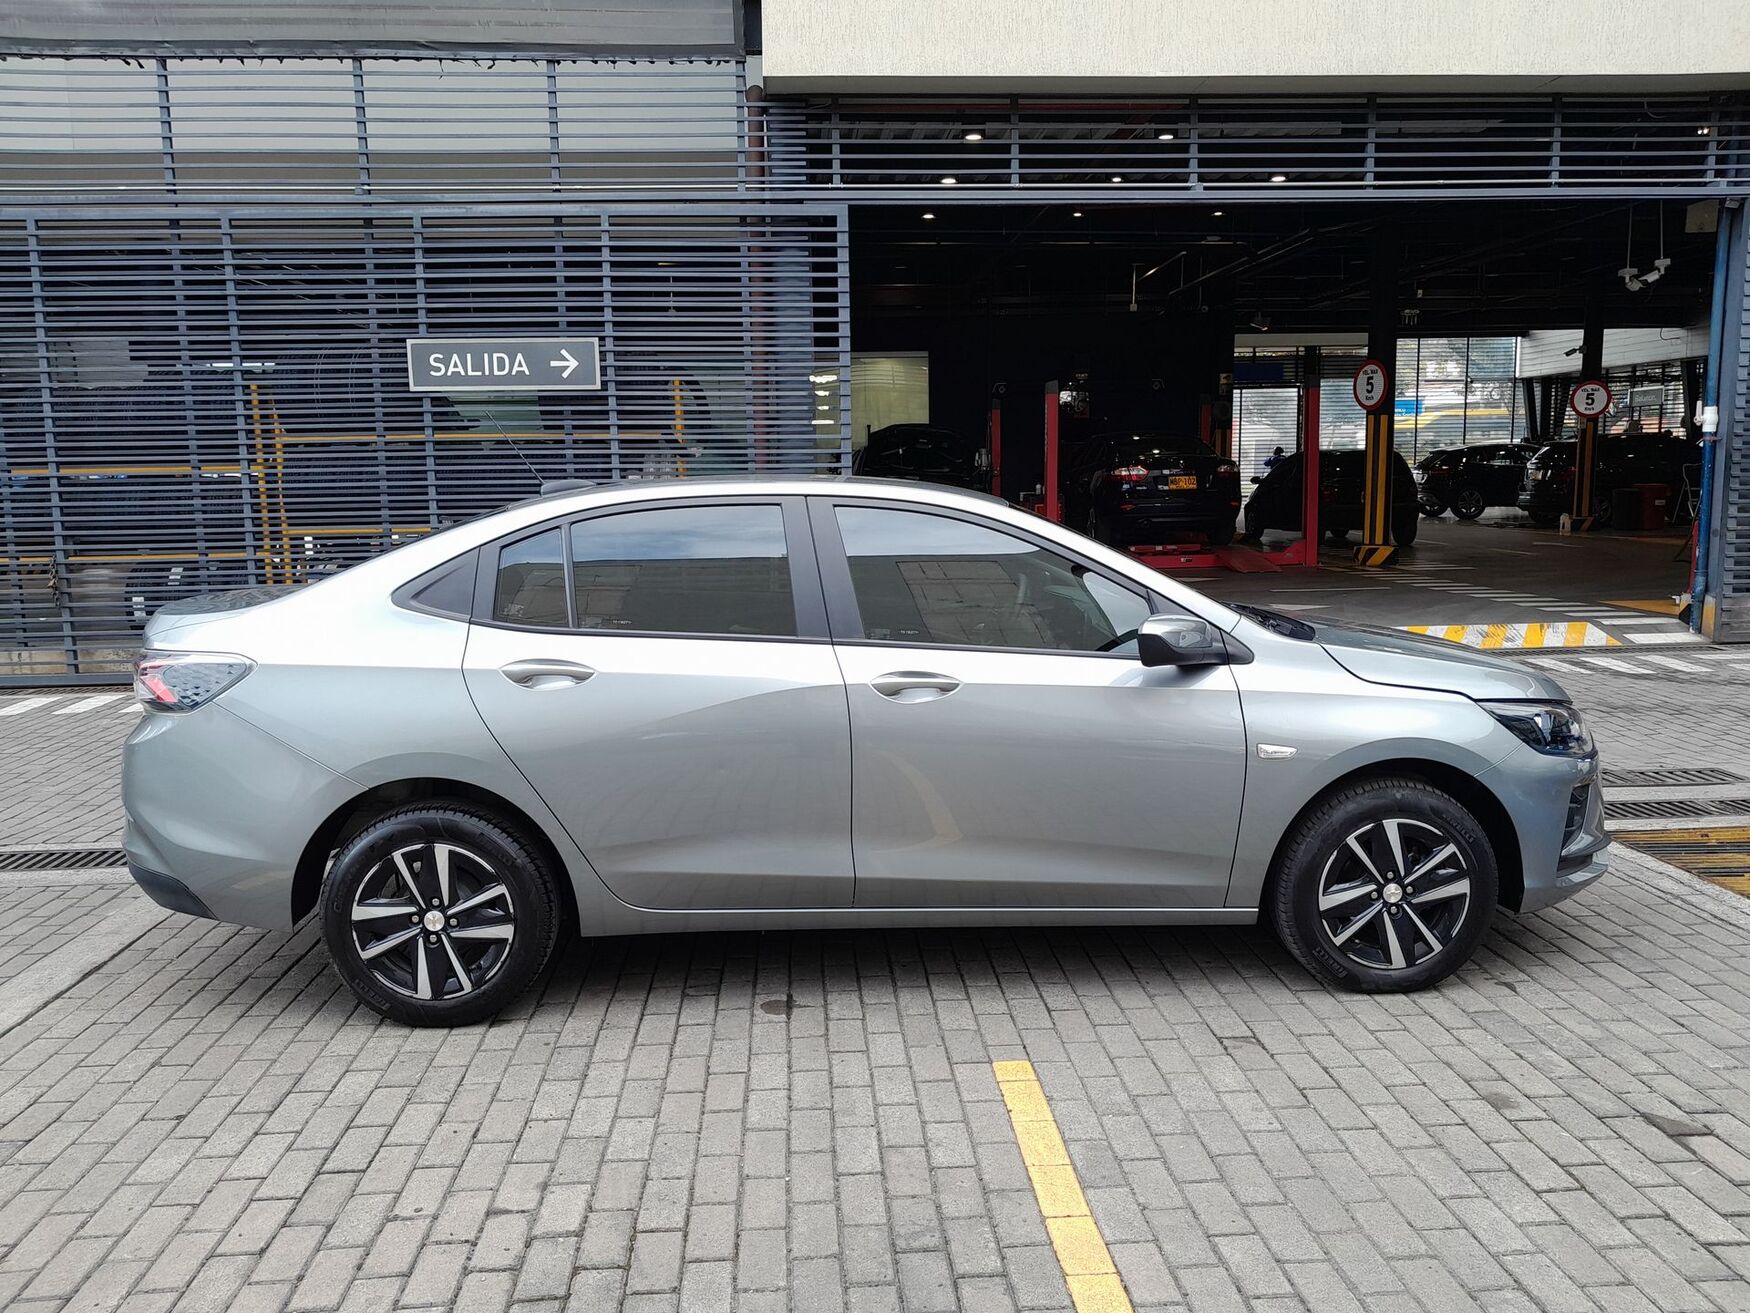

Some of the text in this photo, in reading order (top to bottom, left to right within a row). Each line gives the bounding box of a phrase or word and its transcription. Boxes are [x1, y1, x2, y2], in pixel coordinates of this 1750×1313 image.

[429, 352, 530, 377] SALIDA
[1365, 375, 1374, 394] 5
[1585, 392, 1595, 406] 5
